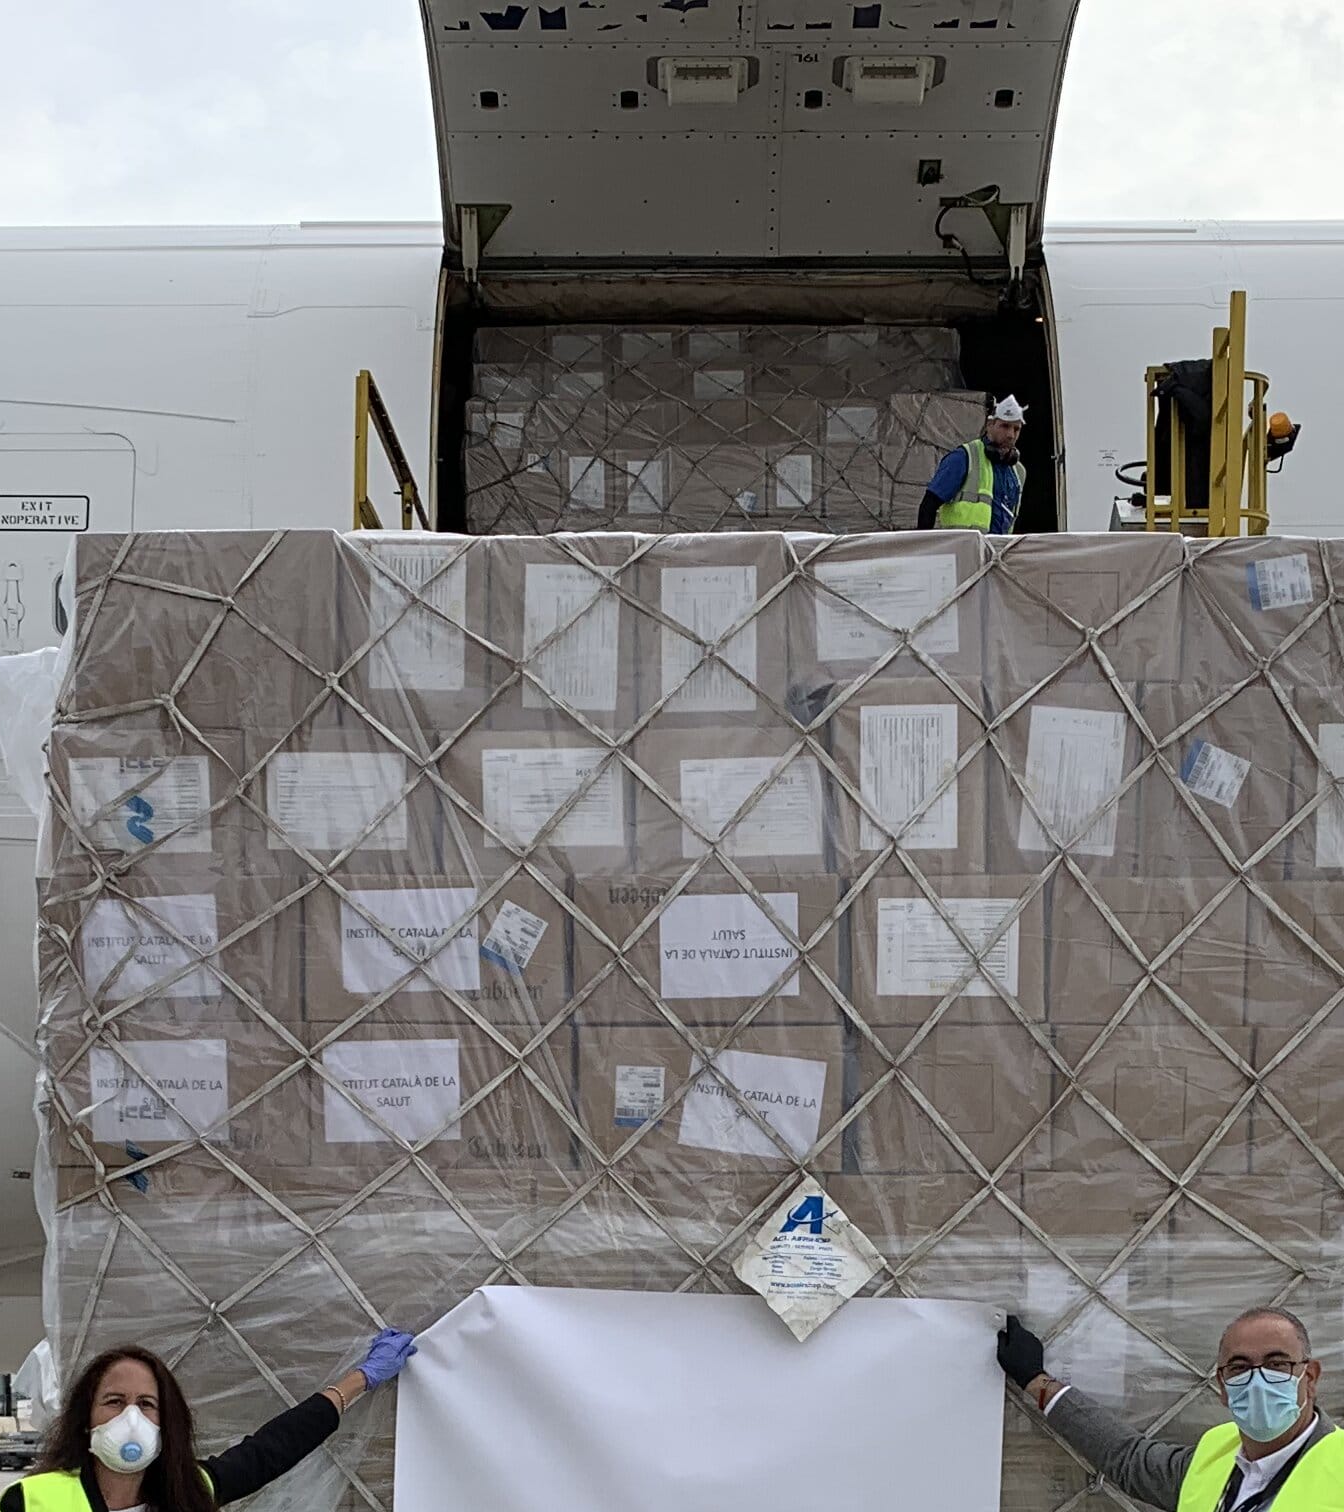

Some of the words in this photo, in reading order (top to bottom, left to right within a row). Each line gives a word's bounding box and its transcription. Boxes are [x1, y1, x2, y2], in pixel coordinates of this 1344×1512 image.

[21, 501, 52, 511] EXIT
[713, 929, 746, 941] SALUT
[665, 951, 680, 960] LA
[682, 949, 696, 959] DE
[743, 948, 792, 959] INSTITUT
[192, 1080, 206, 1090] DE
[210, 1080, 222, 1091] LA
[381, 1075, 422, 1088] CATALÀ
[425, 1077, 440, 1087] DE
[443, 1076, 456, 1087] LA
[377, 1096, 410, 1107] SALUT
[786, 1095, 800, 1107] DE
[803, 1098, 816, 1109] LA
